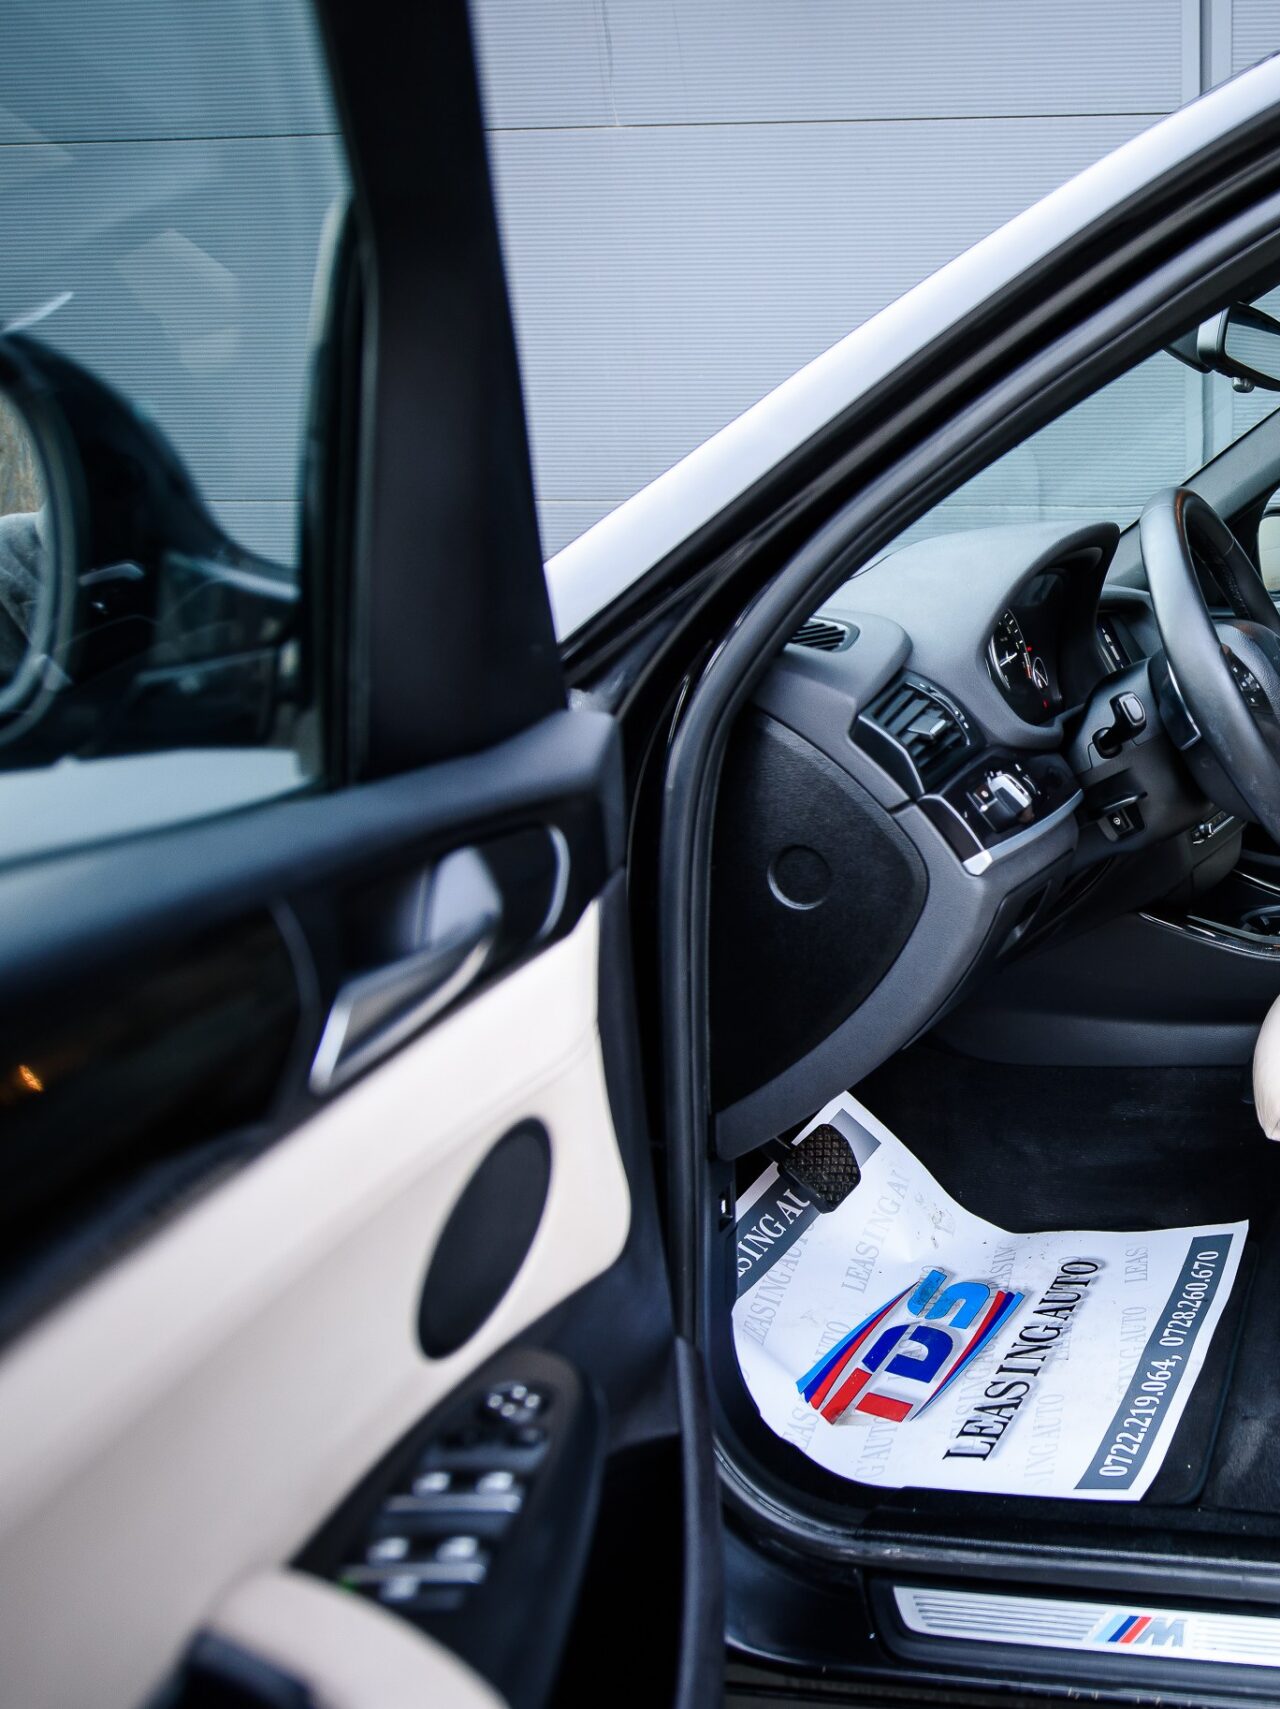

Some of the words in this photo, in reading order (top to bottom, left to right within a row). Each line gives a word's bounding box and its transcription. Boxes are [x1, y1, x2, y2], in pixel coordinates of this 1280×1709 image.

[822, 1268, 992, 1425] TDS
[1099, 1354, 1183, 1477] 0722.219.064,
[1159, 1250, 1219, 1347] 0728.260.670
[1133, 1616, 1187, 1648] M
